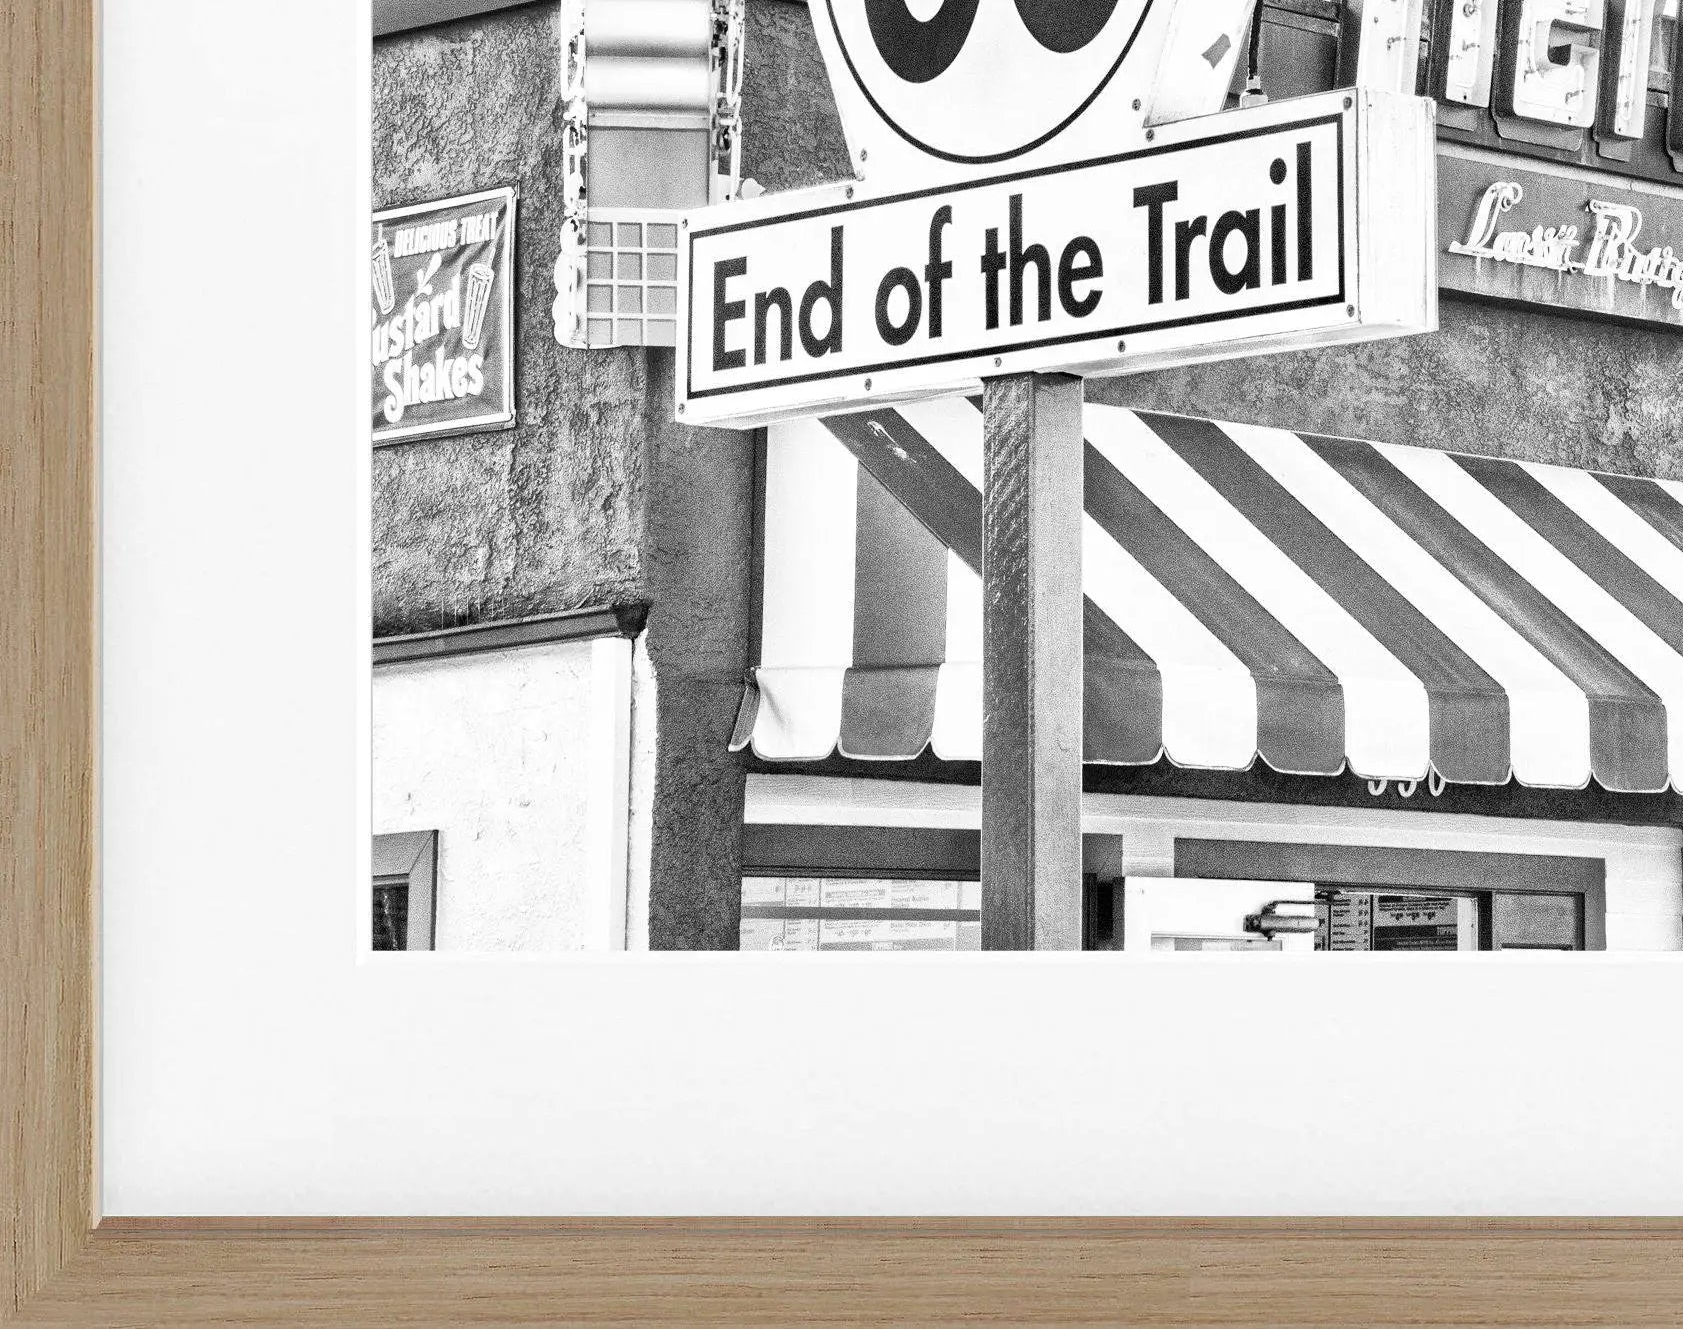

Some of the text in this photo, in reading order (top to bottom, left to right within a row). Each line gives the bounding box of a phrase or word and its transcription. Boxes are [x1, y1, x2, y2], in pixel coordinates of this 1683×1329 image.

[713, 141, 1315, 369] End of the Trail
[1449, 182, 1580, 272] Last
[372, 272, 461, 368] ustard
[383, 344, 484, 424] Shakes
